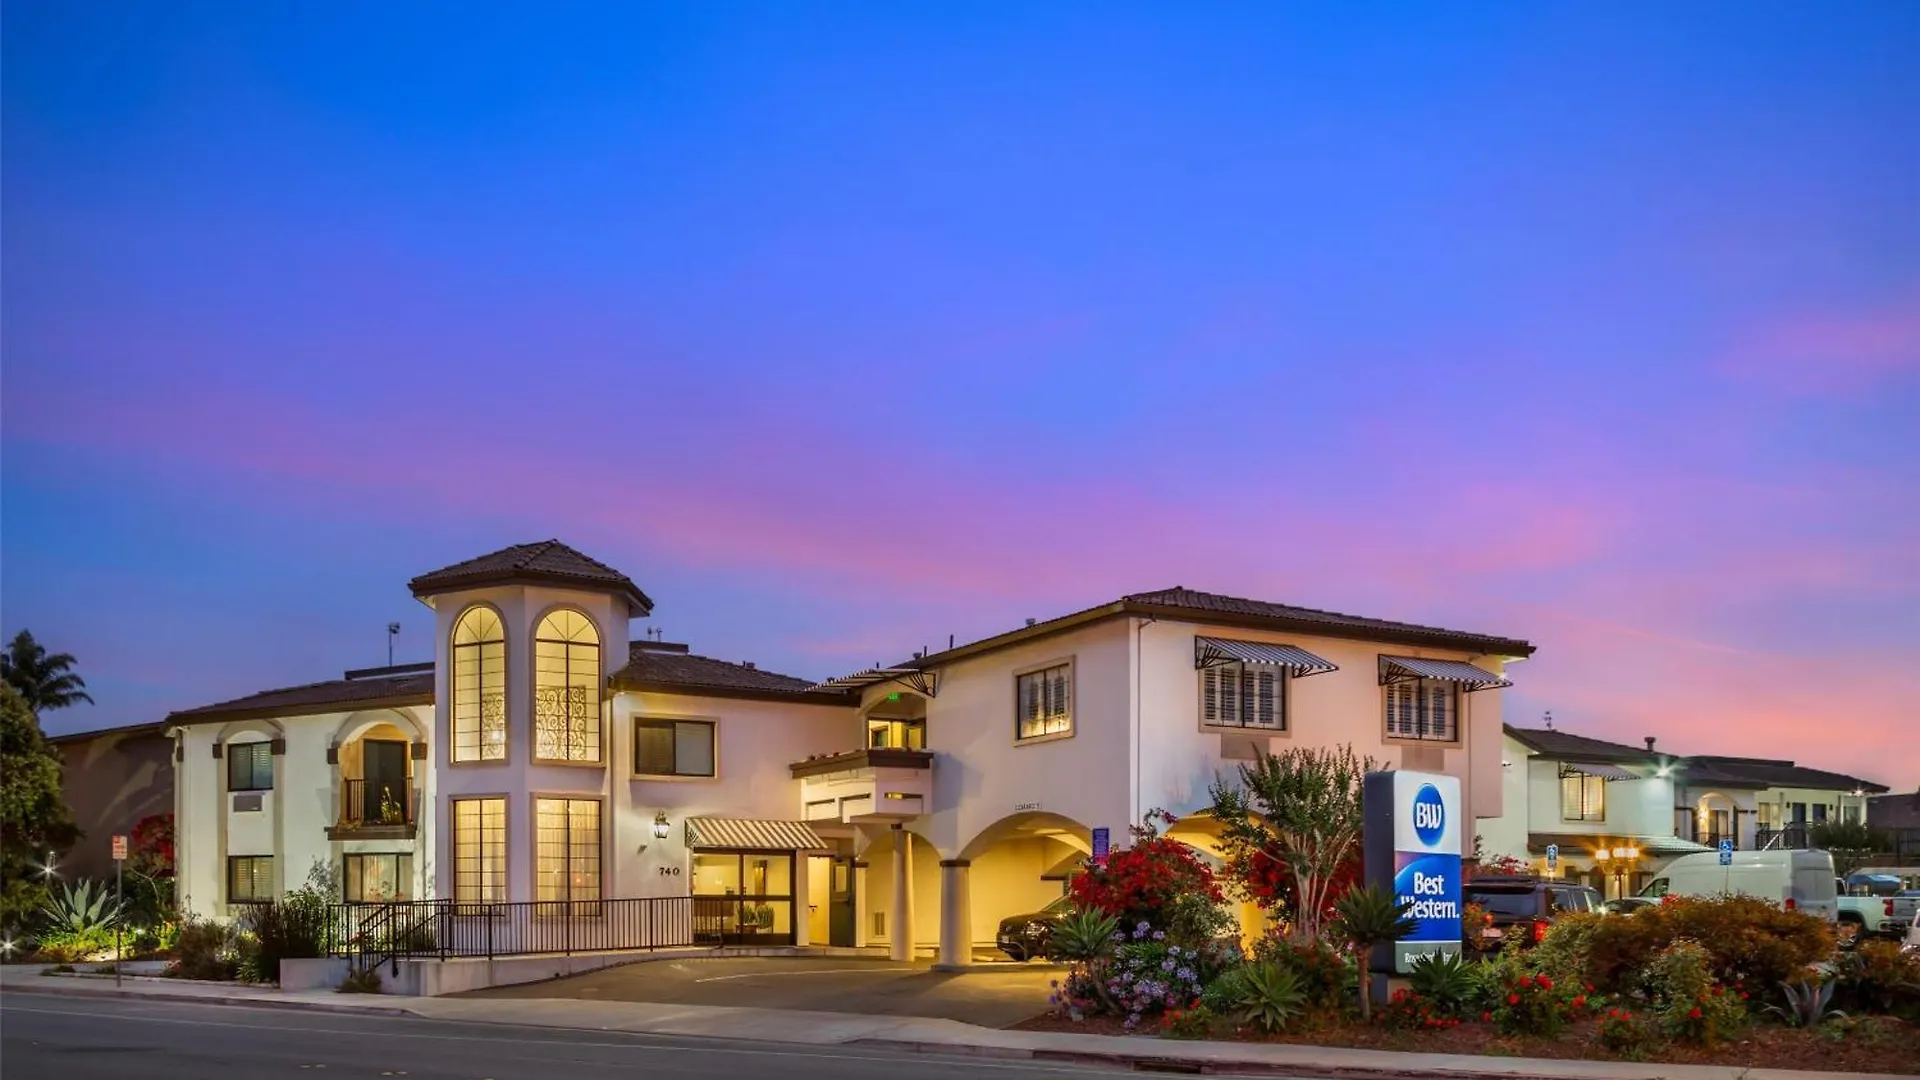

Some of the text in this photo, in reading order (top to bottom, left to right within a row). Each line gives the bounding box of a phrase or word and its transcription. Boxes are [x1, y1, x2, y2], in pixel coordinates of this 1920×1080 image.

[1416, 803, 1442, 829] BW
[659, 867, 680, 876] 740
[1413, 872, 1445, 895] Best
